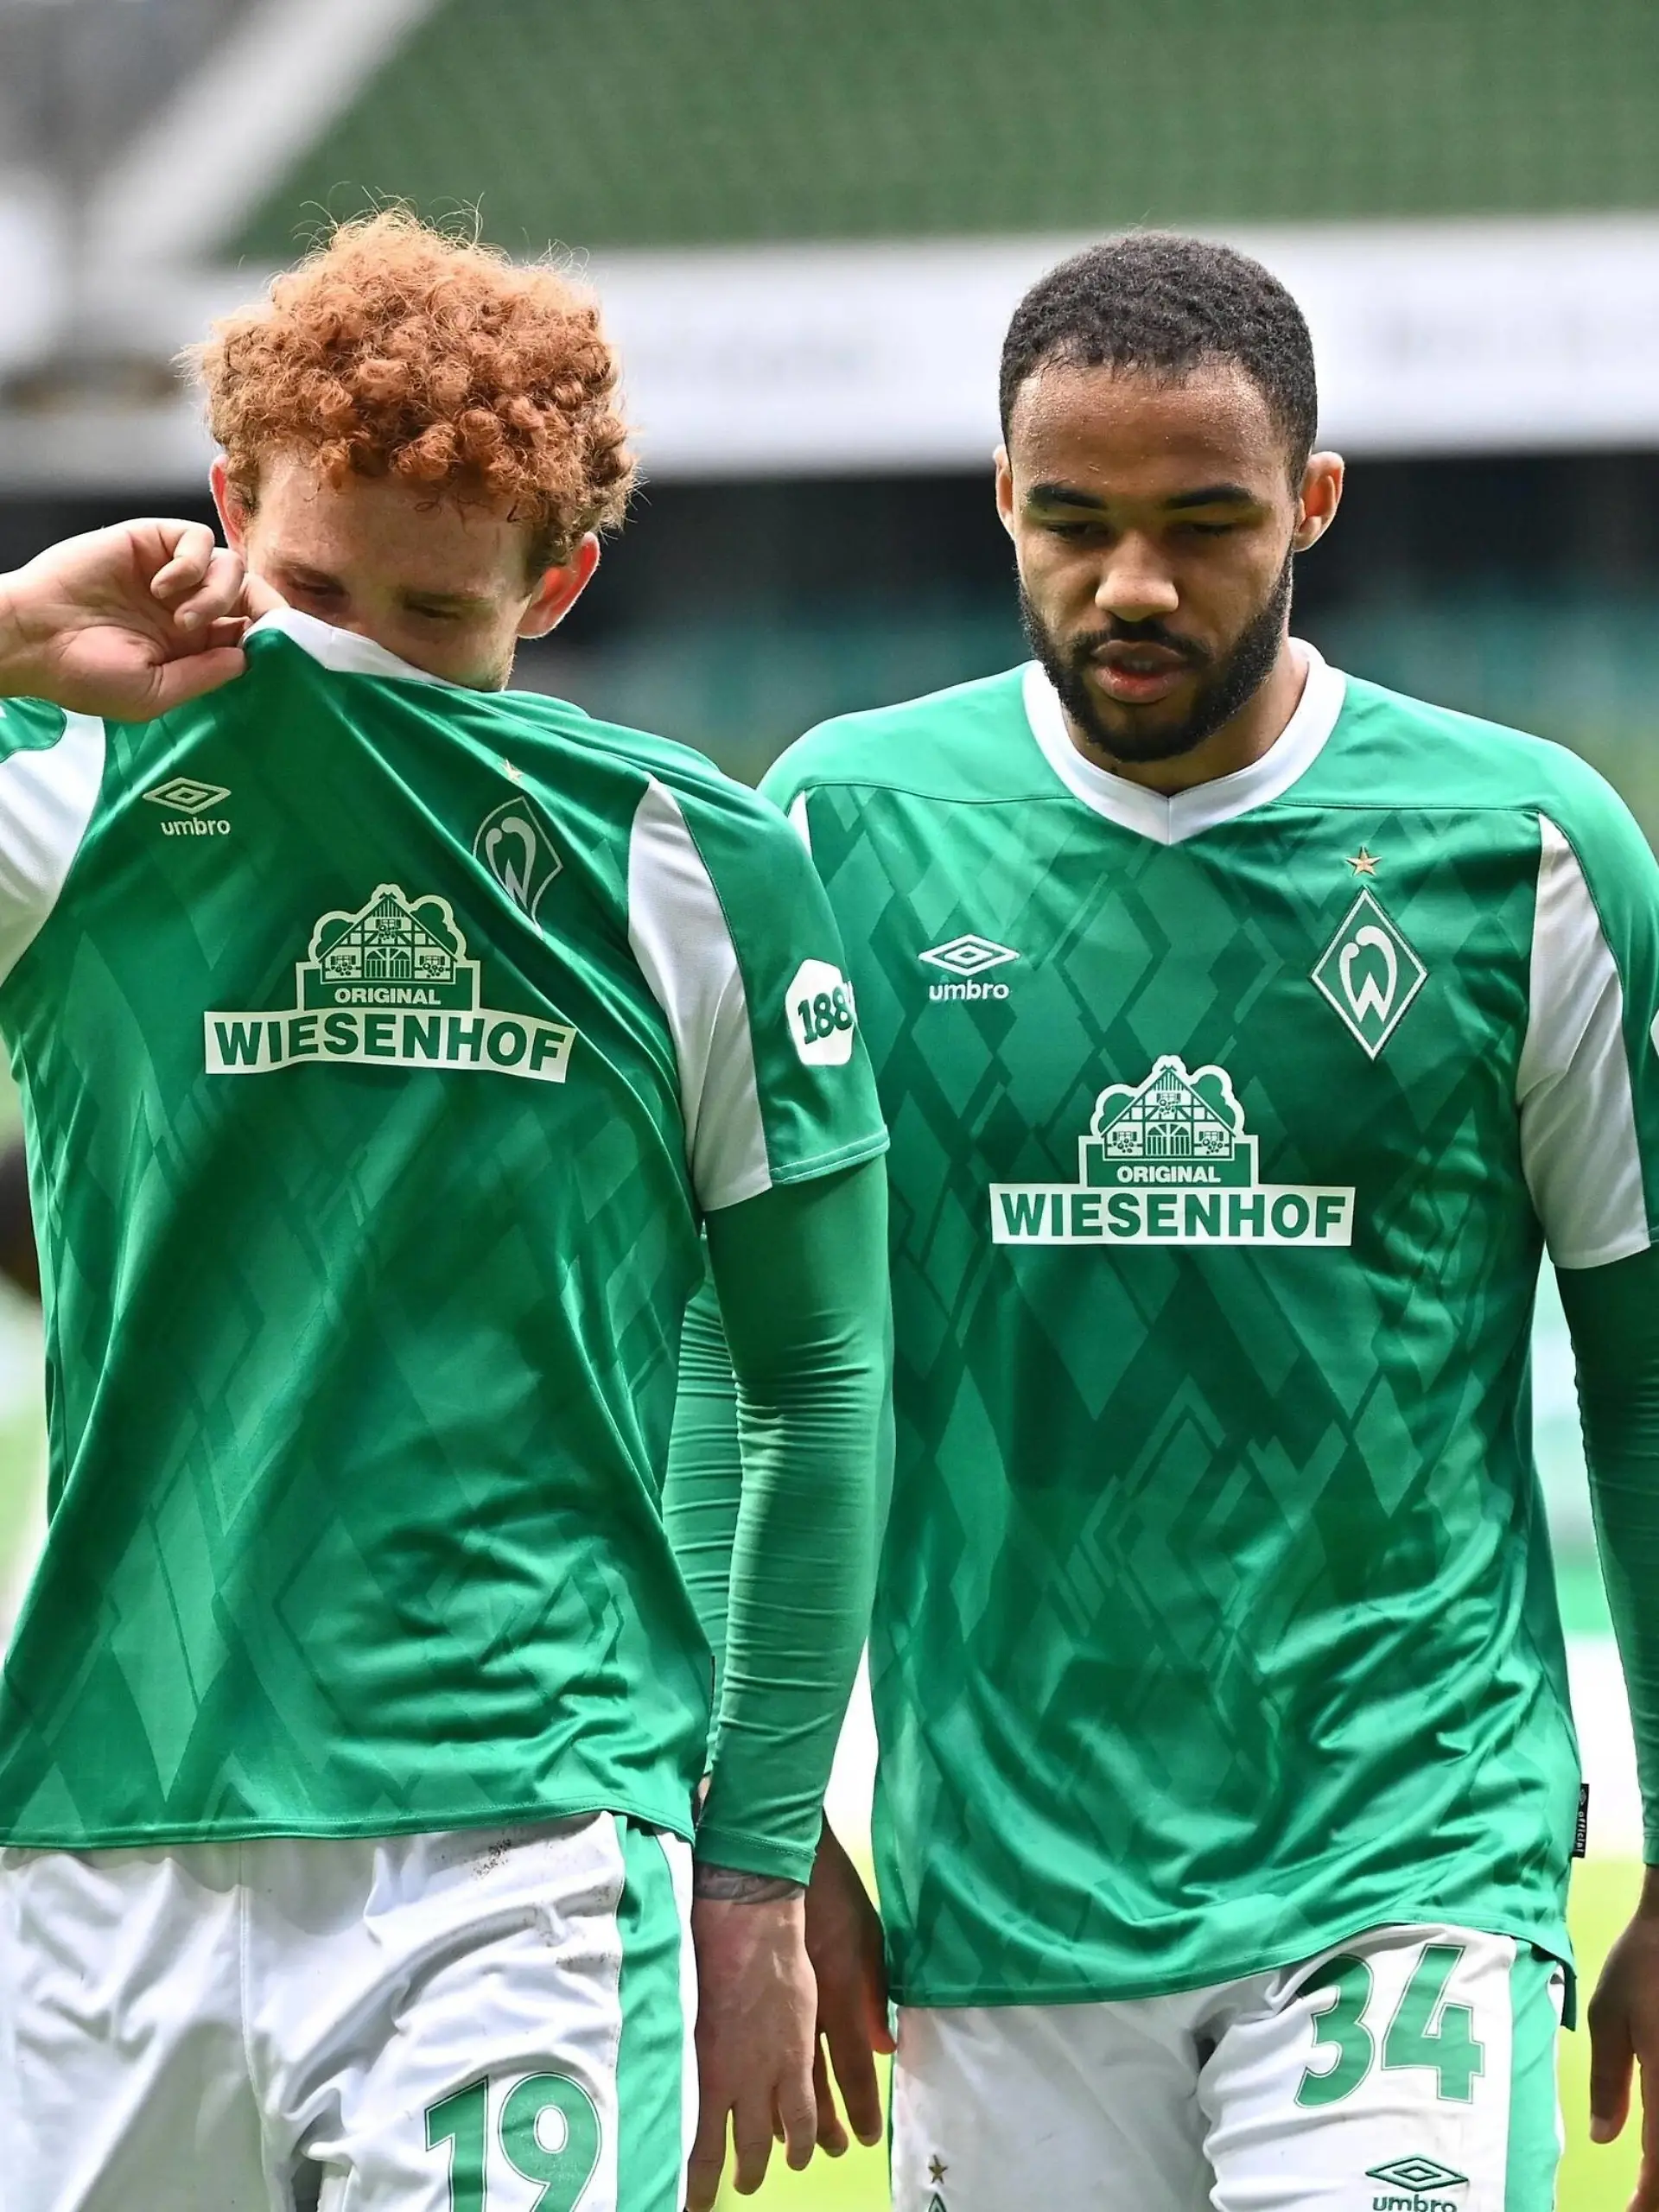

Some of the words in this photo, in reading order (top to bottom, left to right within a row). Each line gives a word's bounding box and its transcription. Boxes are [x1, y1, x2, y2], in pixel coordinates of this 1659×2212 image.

[161, 817, 231, 836] umbro
[334, 988, 442, 1005] ORIGINAL
[928, 980, 1010, 1002] umbro
[214, 1014, 567, 1071] WIESENHOF
[1116, 1166, 1221, 1183] ORIGINAL
[1000, 1193, 1346, 1238] WIESENHOF
[1294, 1943, 1484, 2109] 34
[424, 2071, 602, 2212] 19
[1372, 2194, 1457, 2212] umbro
